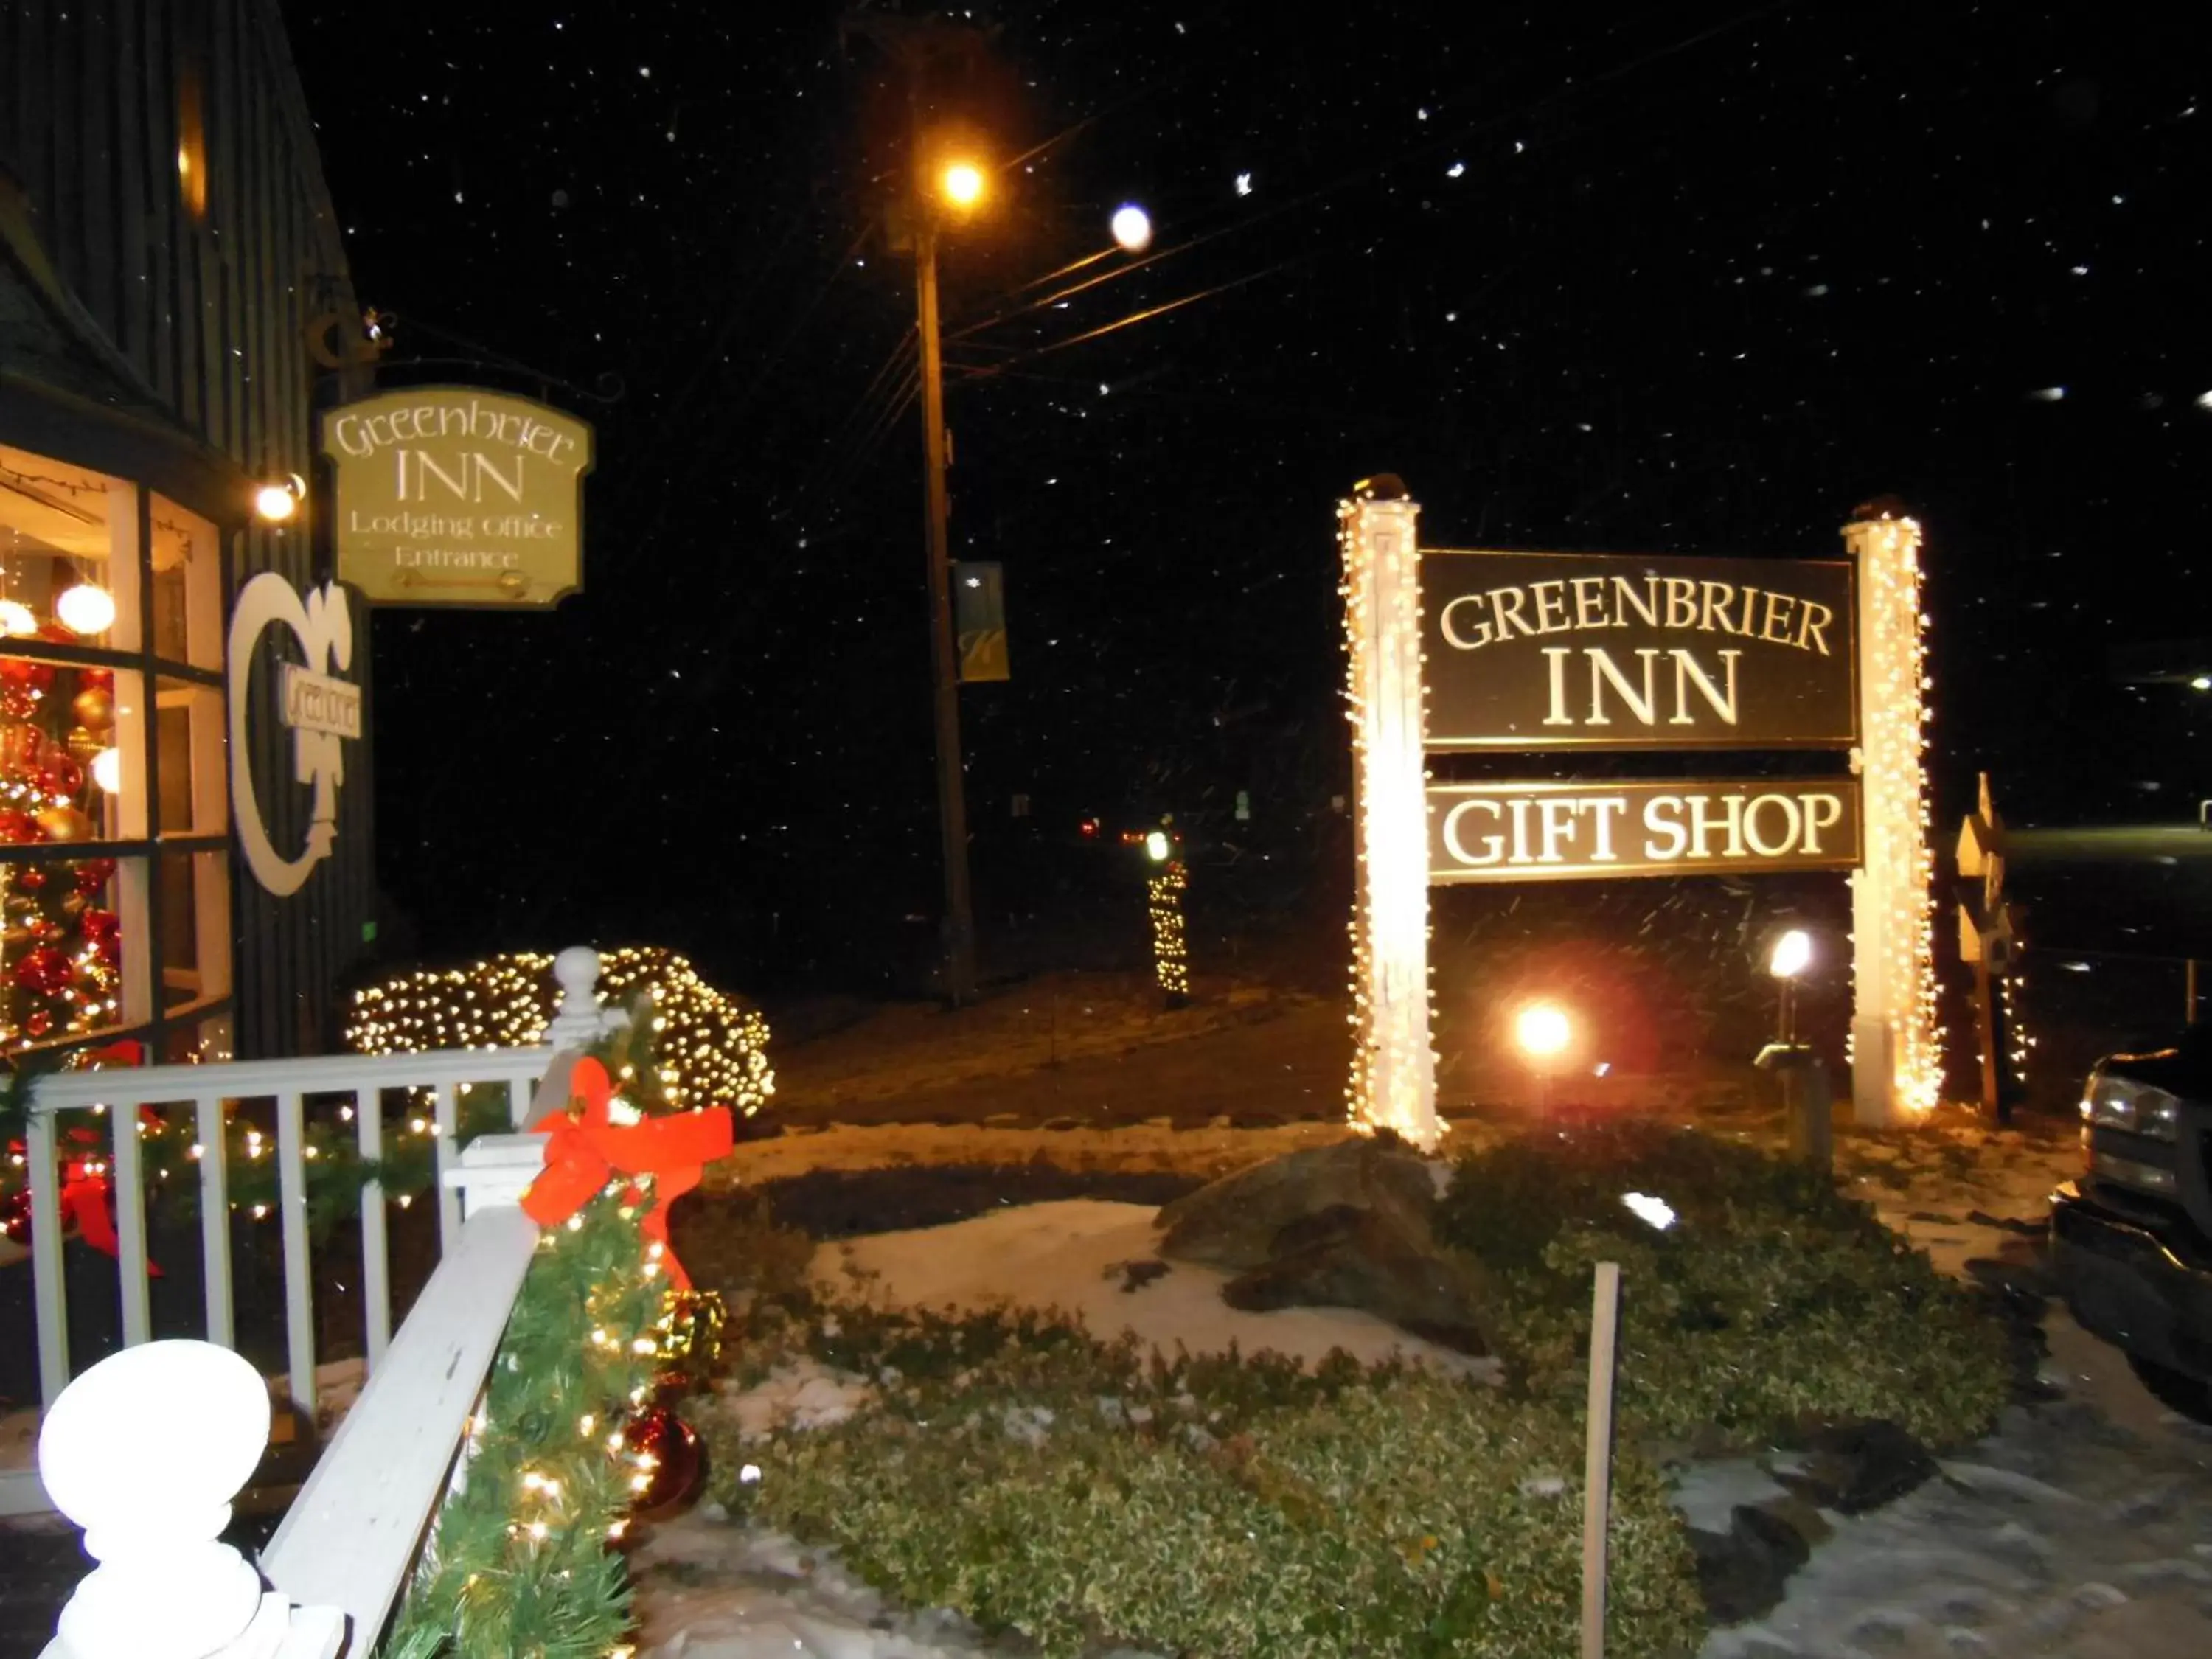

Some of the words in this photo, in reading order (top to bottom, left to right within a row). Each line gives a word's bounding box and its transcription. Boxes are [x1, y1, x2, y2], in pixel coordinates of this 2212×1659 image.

[336, 400, 574, 465] Greenbrier
[396, 449, 525, 504] INN
[350, 509, 474, 540] Lodging
[394, 546, 520, 568] Entrance
[1440, 576, 1833, 656] GREENBRIER
[1540, 647, 1743, 726] INN
[1443, 797, 1627, 866] GIFT
[1643, 794, 1842, 860] SHOP
